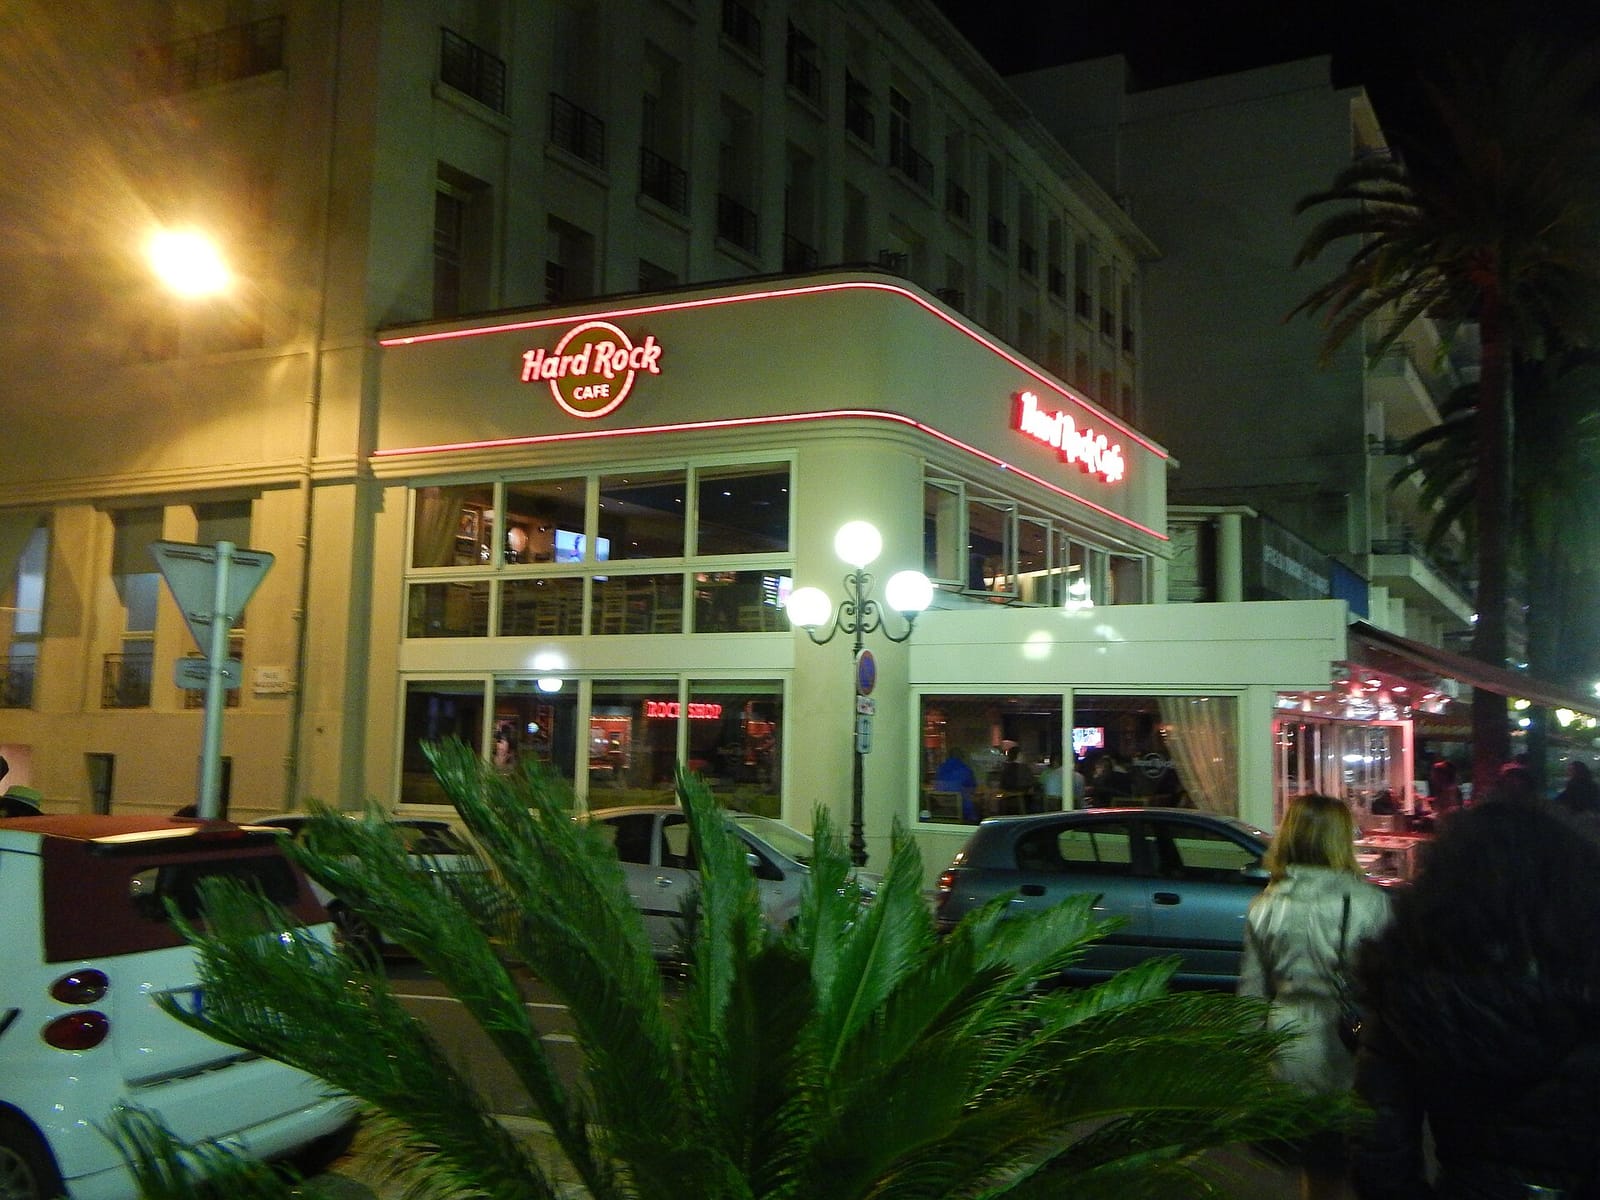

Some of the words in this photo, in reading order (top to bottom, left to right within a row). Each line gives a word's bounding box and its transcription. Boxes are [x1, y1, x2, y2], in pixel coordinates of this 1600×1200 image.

[521, 342, 593, 382] Hard
[594, 335, 662, 379] Rock
[573, 383, 610, 400] CAFE
